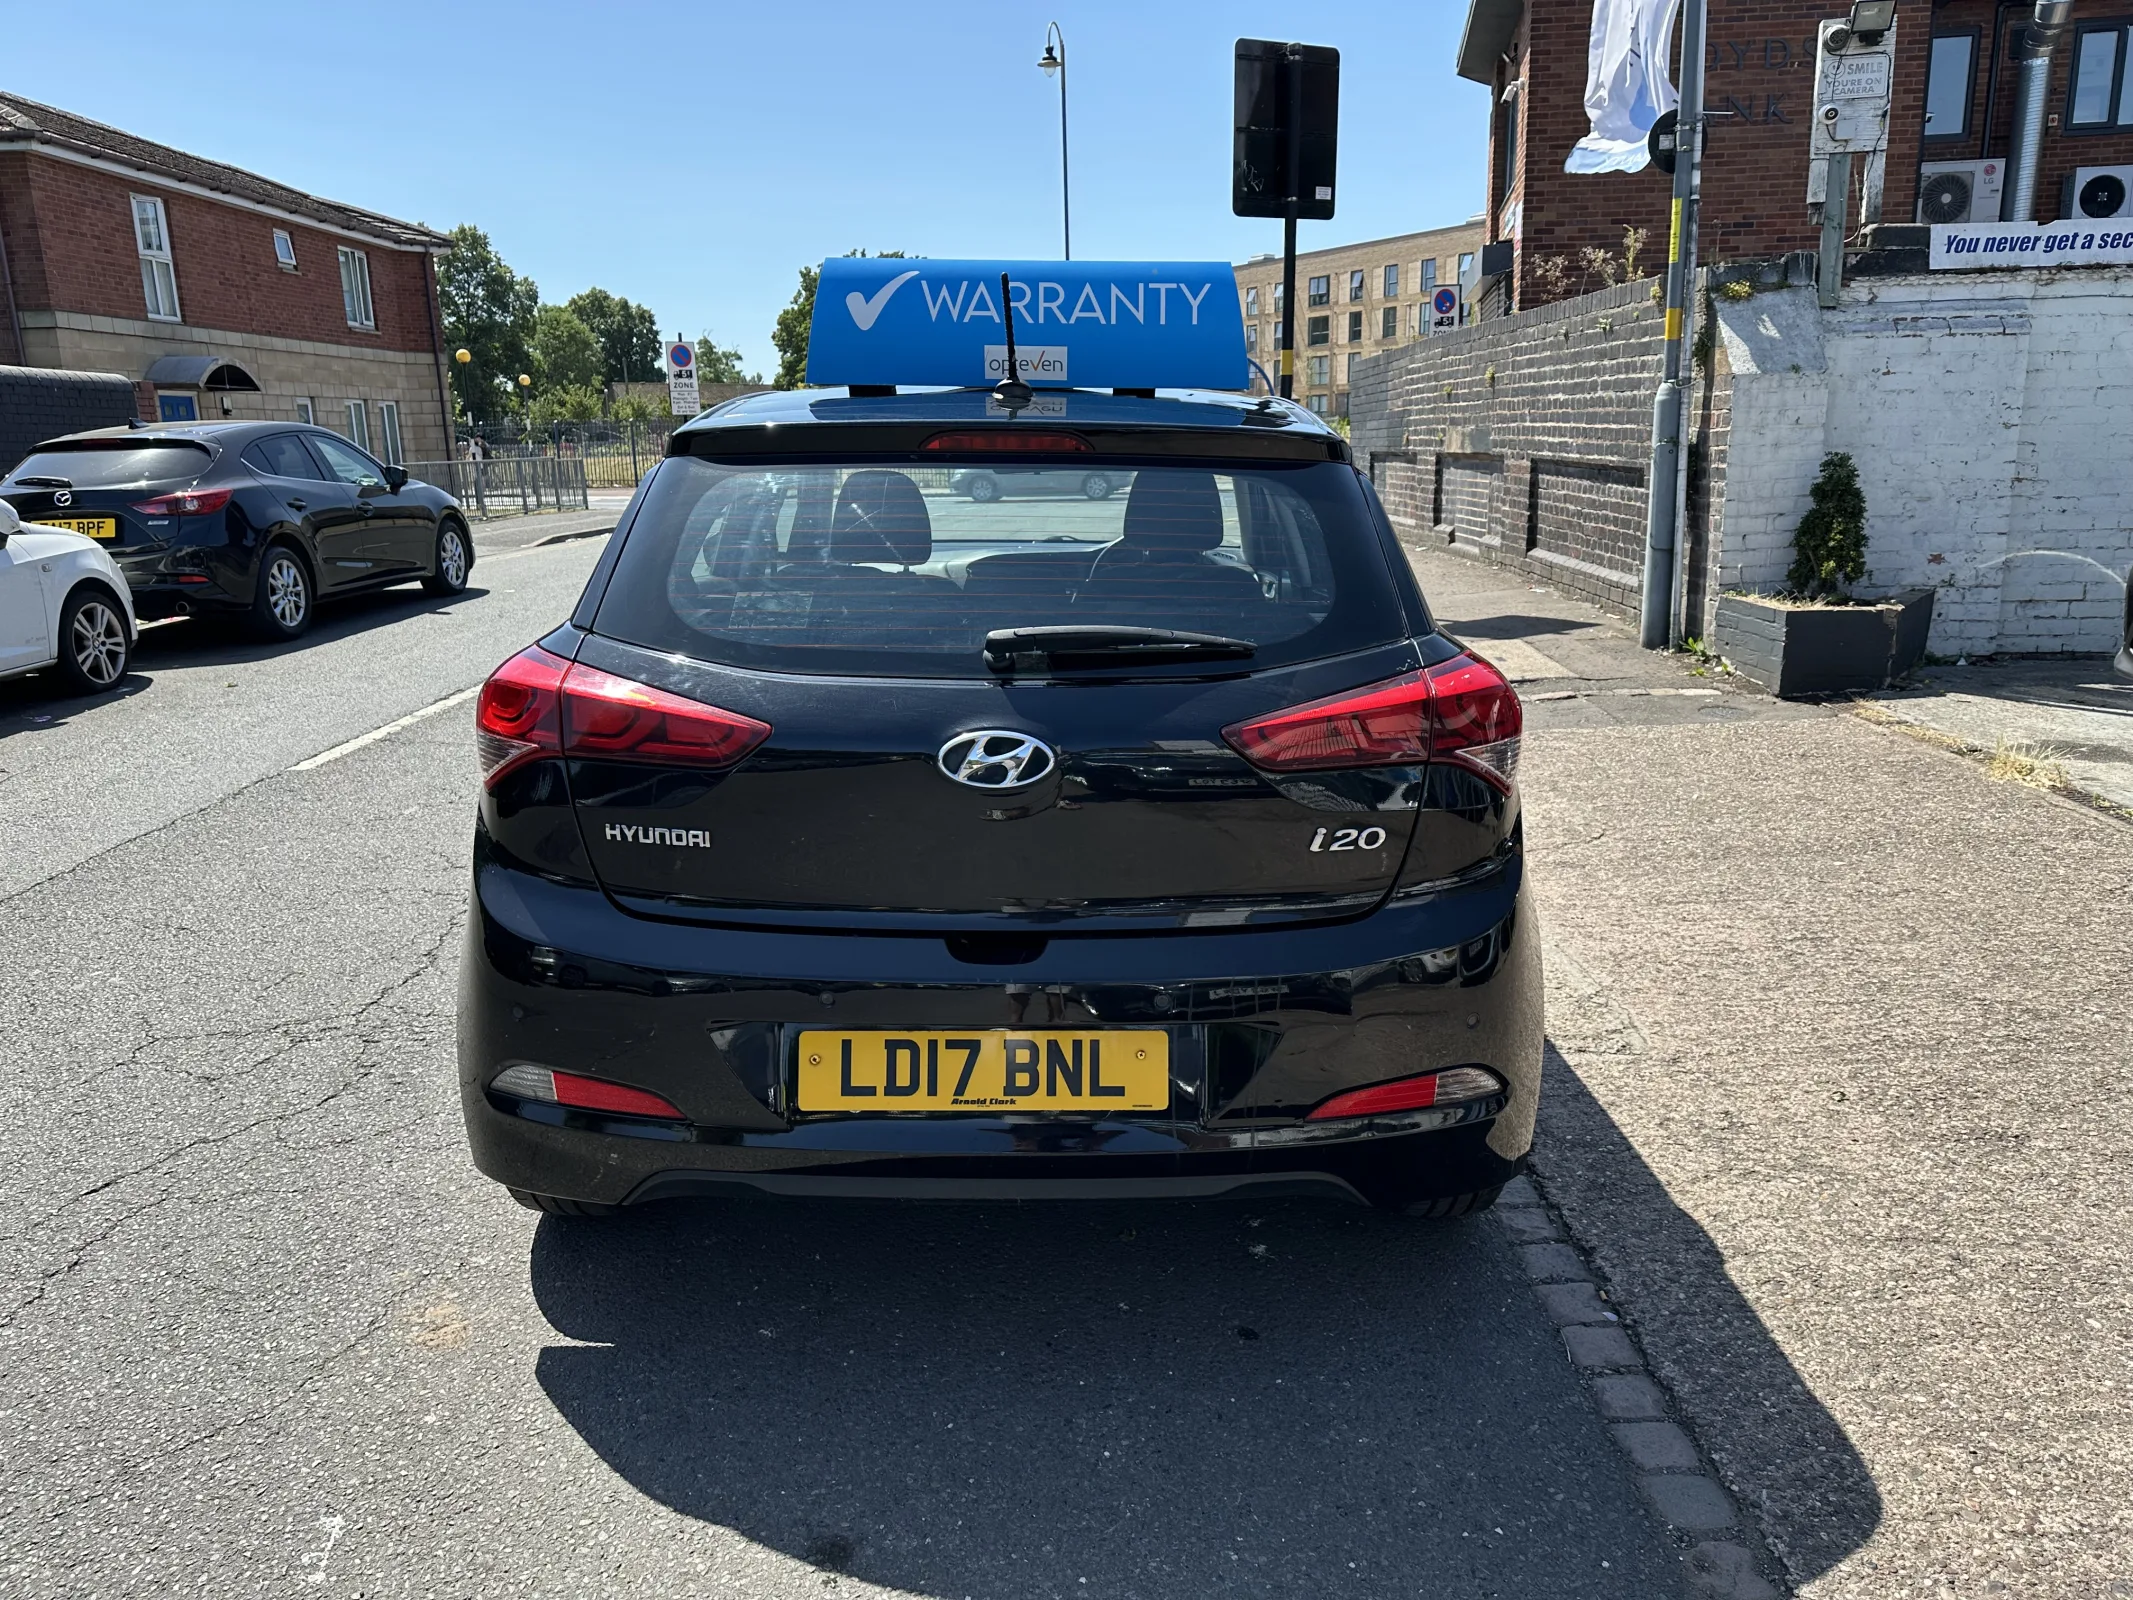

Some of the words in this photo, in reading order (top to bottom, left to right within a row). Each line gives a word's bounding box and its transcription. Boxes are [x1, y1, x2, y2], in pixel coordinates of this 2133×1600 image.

[1847, 62, 1883, 75] SMILE
[1826, 79, 1862, 89] YOU'RE
[1865, 77, 1882, 86] ON
[1833, 86, 1874, 95] CAMERA
[1945, 234, 1980, 253] You
[1982, 235, 2042, 253] never
[2043, 232, 2079, 253] get
[2080, 233, 2094, 249] a
[2098, 232, 2133, 249] sec
[921, 280, 1211, 325] WARRANTY
[989, 350, 1064, 375] opeven
[76, 521, 106, 535] BPF
[605, 823, 711, 848] HYUNDAI
[1309, 827, 1386, 852] i20
[841, 1039, 982, 1097] LD17
[1003, 1039, 1125, 1097] BNL
